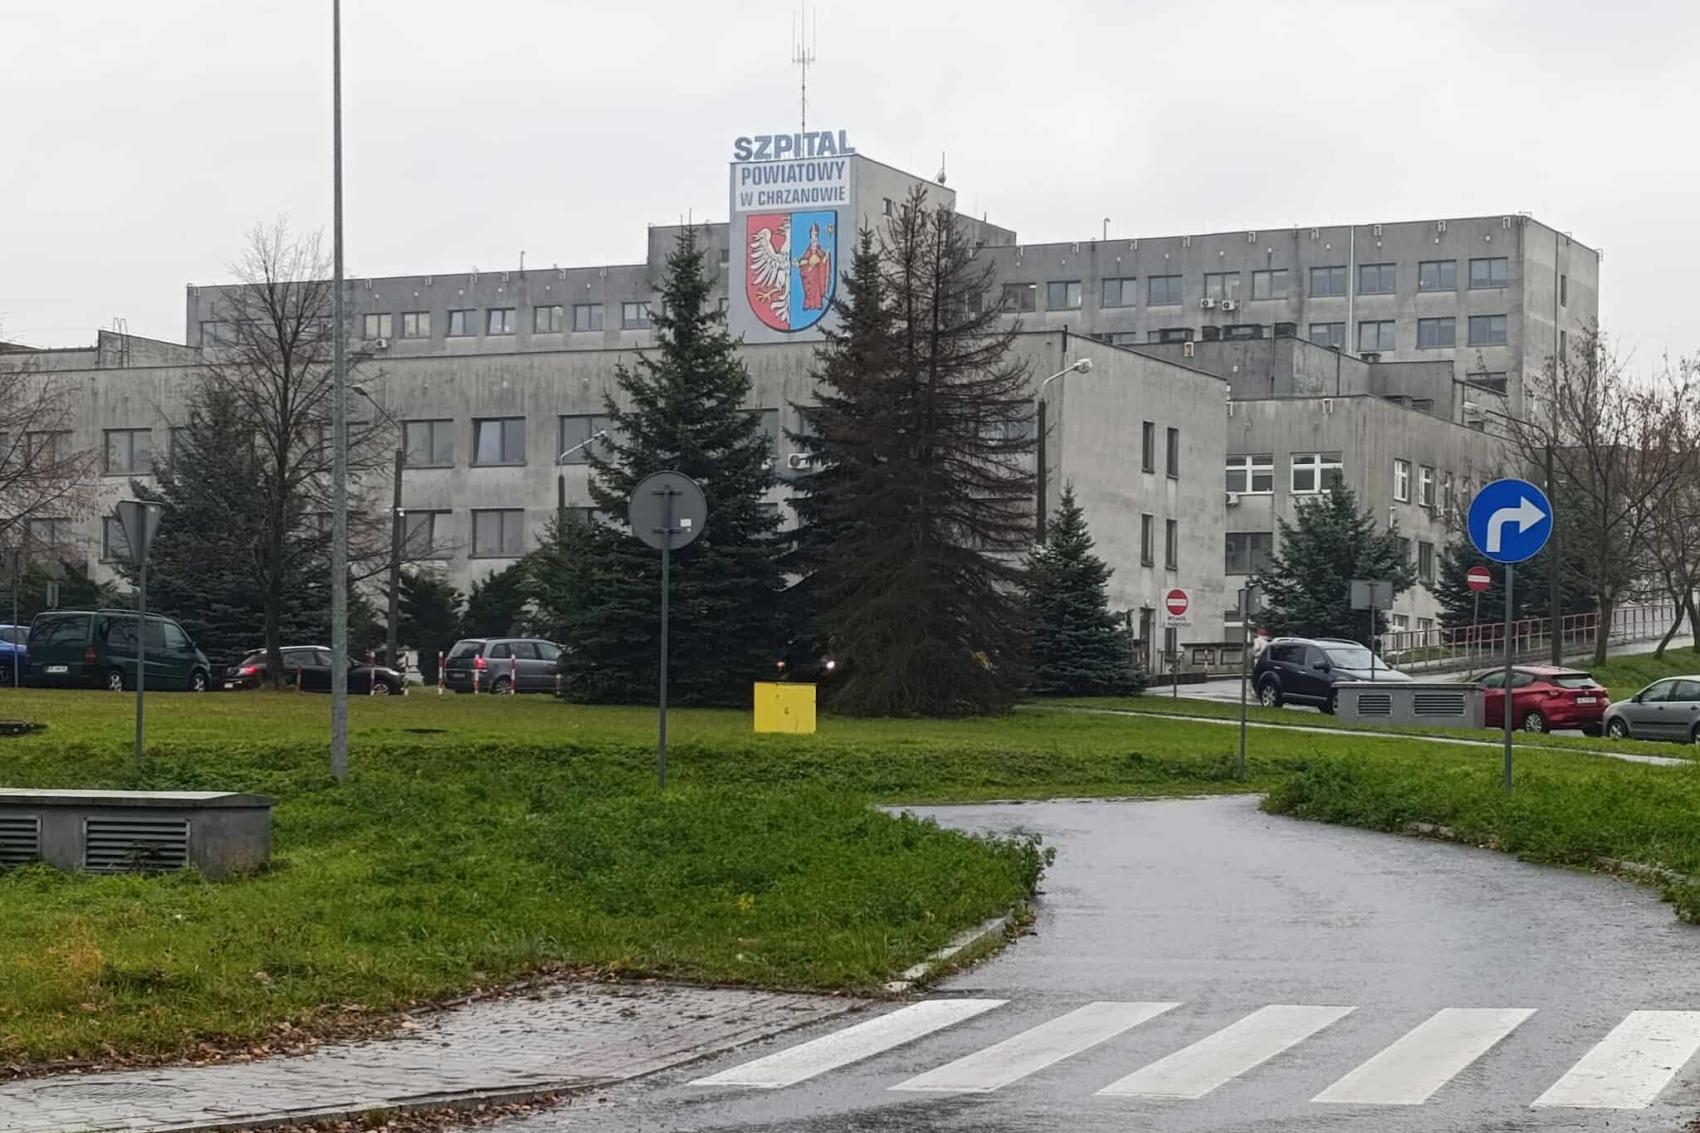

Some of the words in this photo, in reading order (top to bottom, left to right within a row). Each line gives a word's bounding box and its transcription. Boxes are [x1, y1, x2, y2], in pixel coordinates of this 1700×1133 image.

[734, 130, 855, 161] SZPITAL
[741, 161, 845, 186] POWIATOWY
[740, 192, 753, 207] W
[758, 186, 845, 206] CHRZANOWIE
